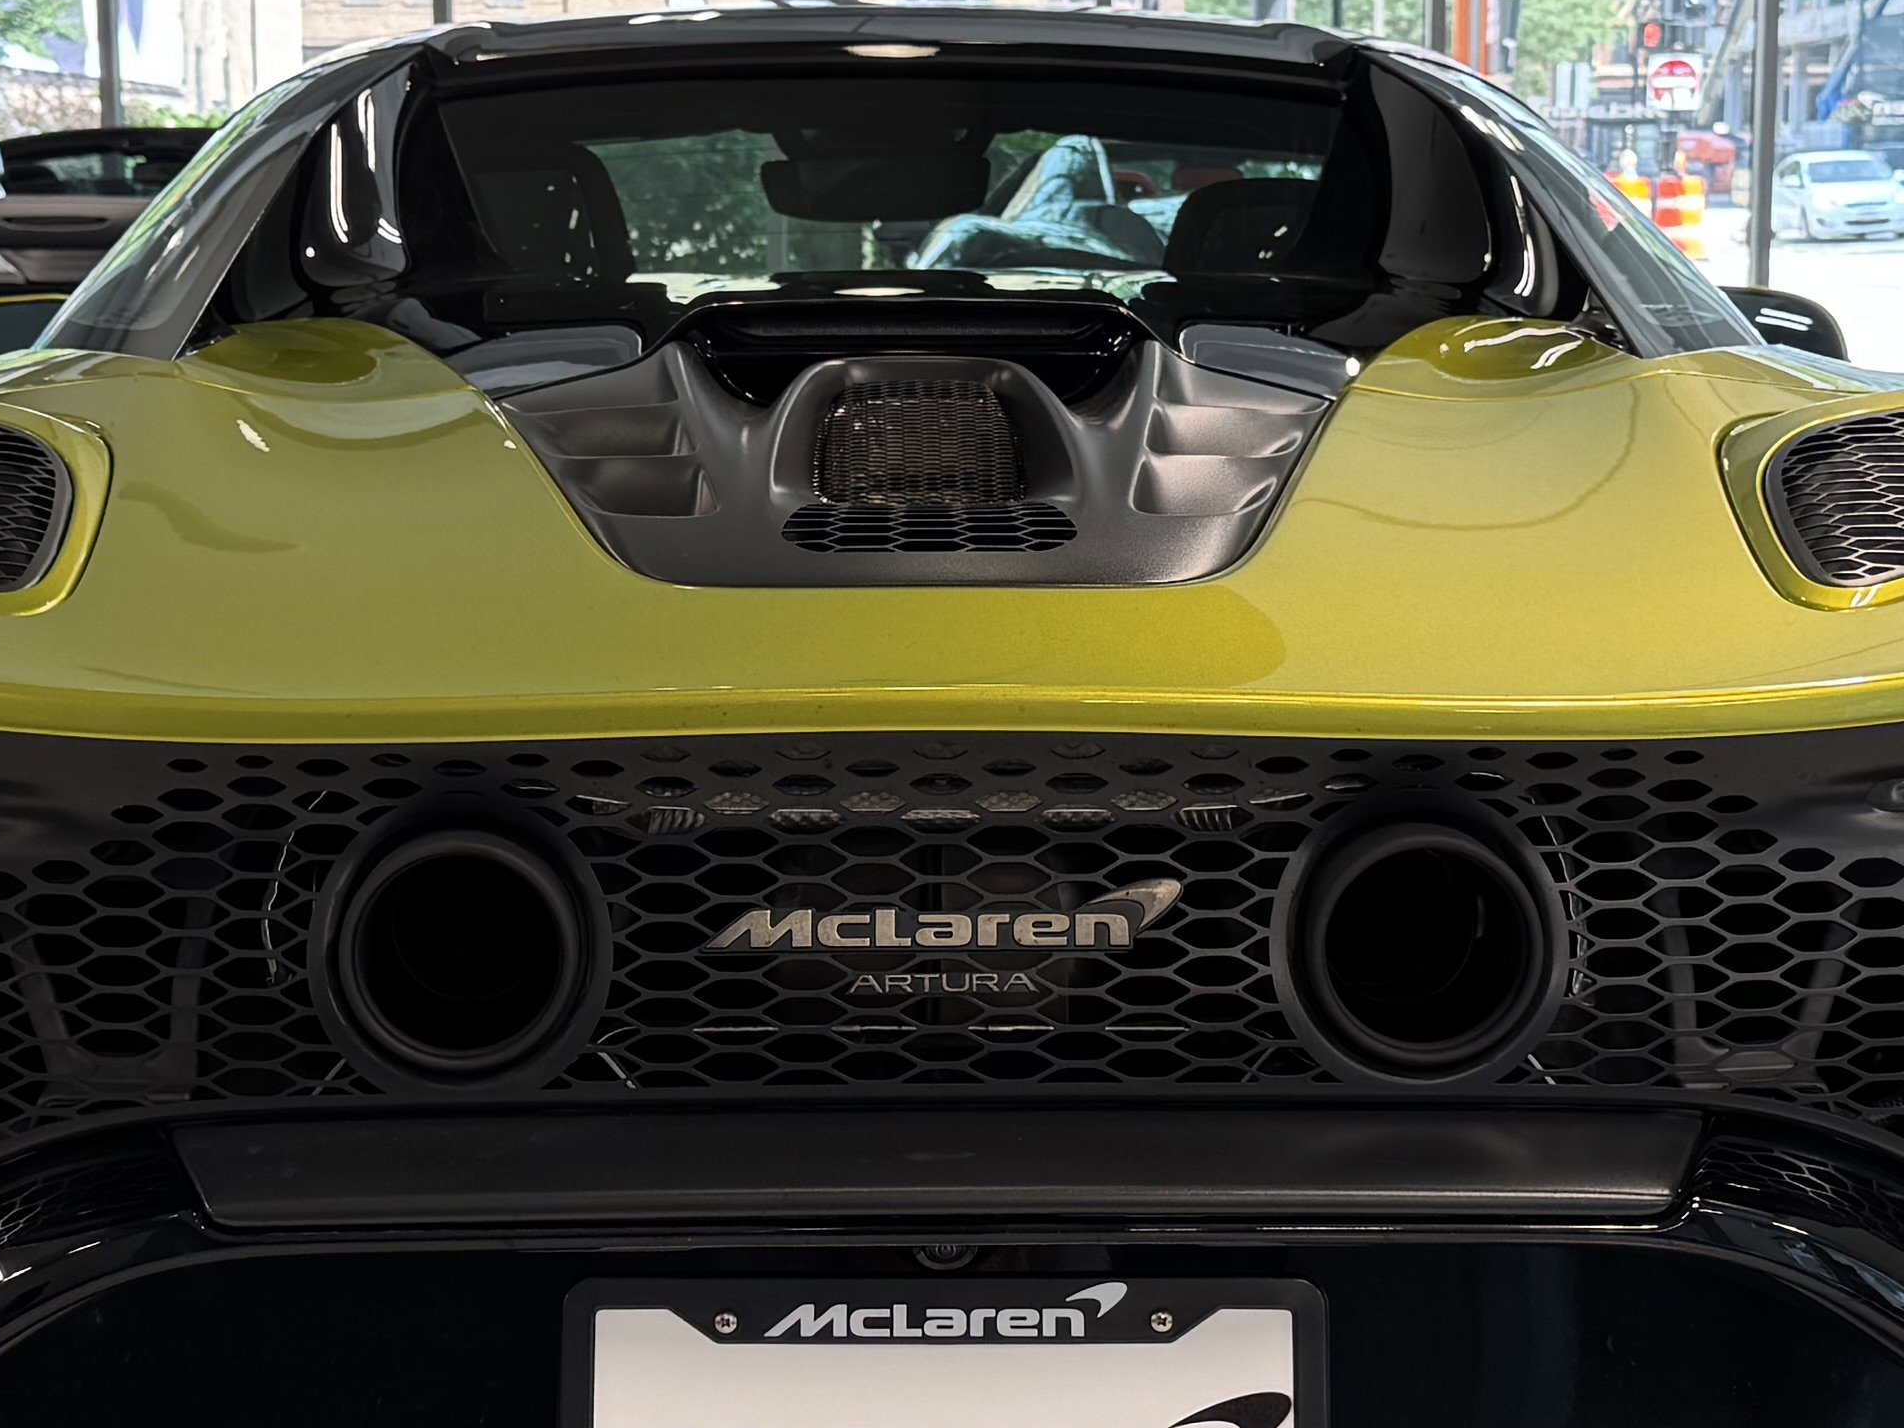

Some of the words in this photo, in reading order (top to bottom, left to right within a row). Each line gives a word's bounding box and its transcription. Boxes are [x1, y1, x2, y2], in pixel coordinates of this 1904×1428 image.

[704, 908, 1132, 949] McLaren
[848, 972, 1039, 994] ARTURA
[763, 1303, 1085, 1338] McLaren
